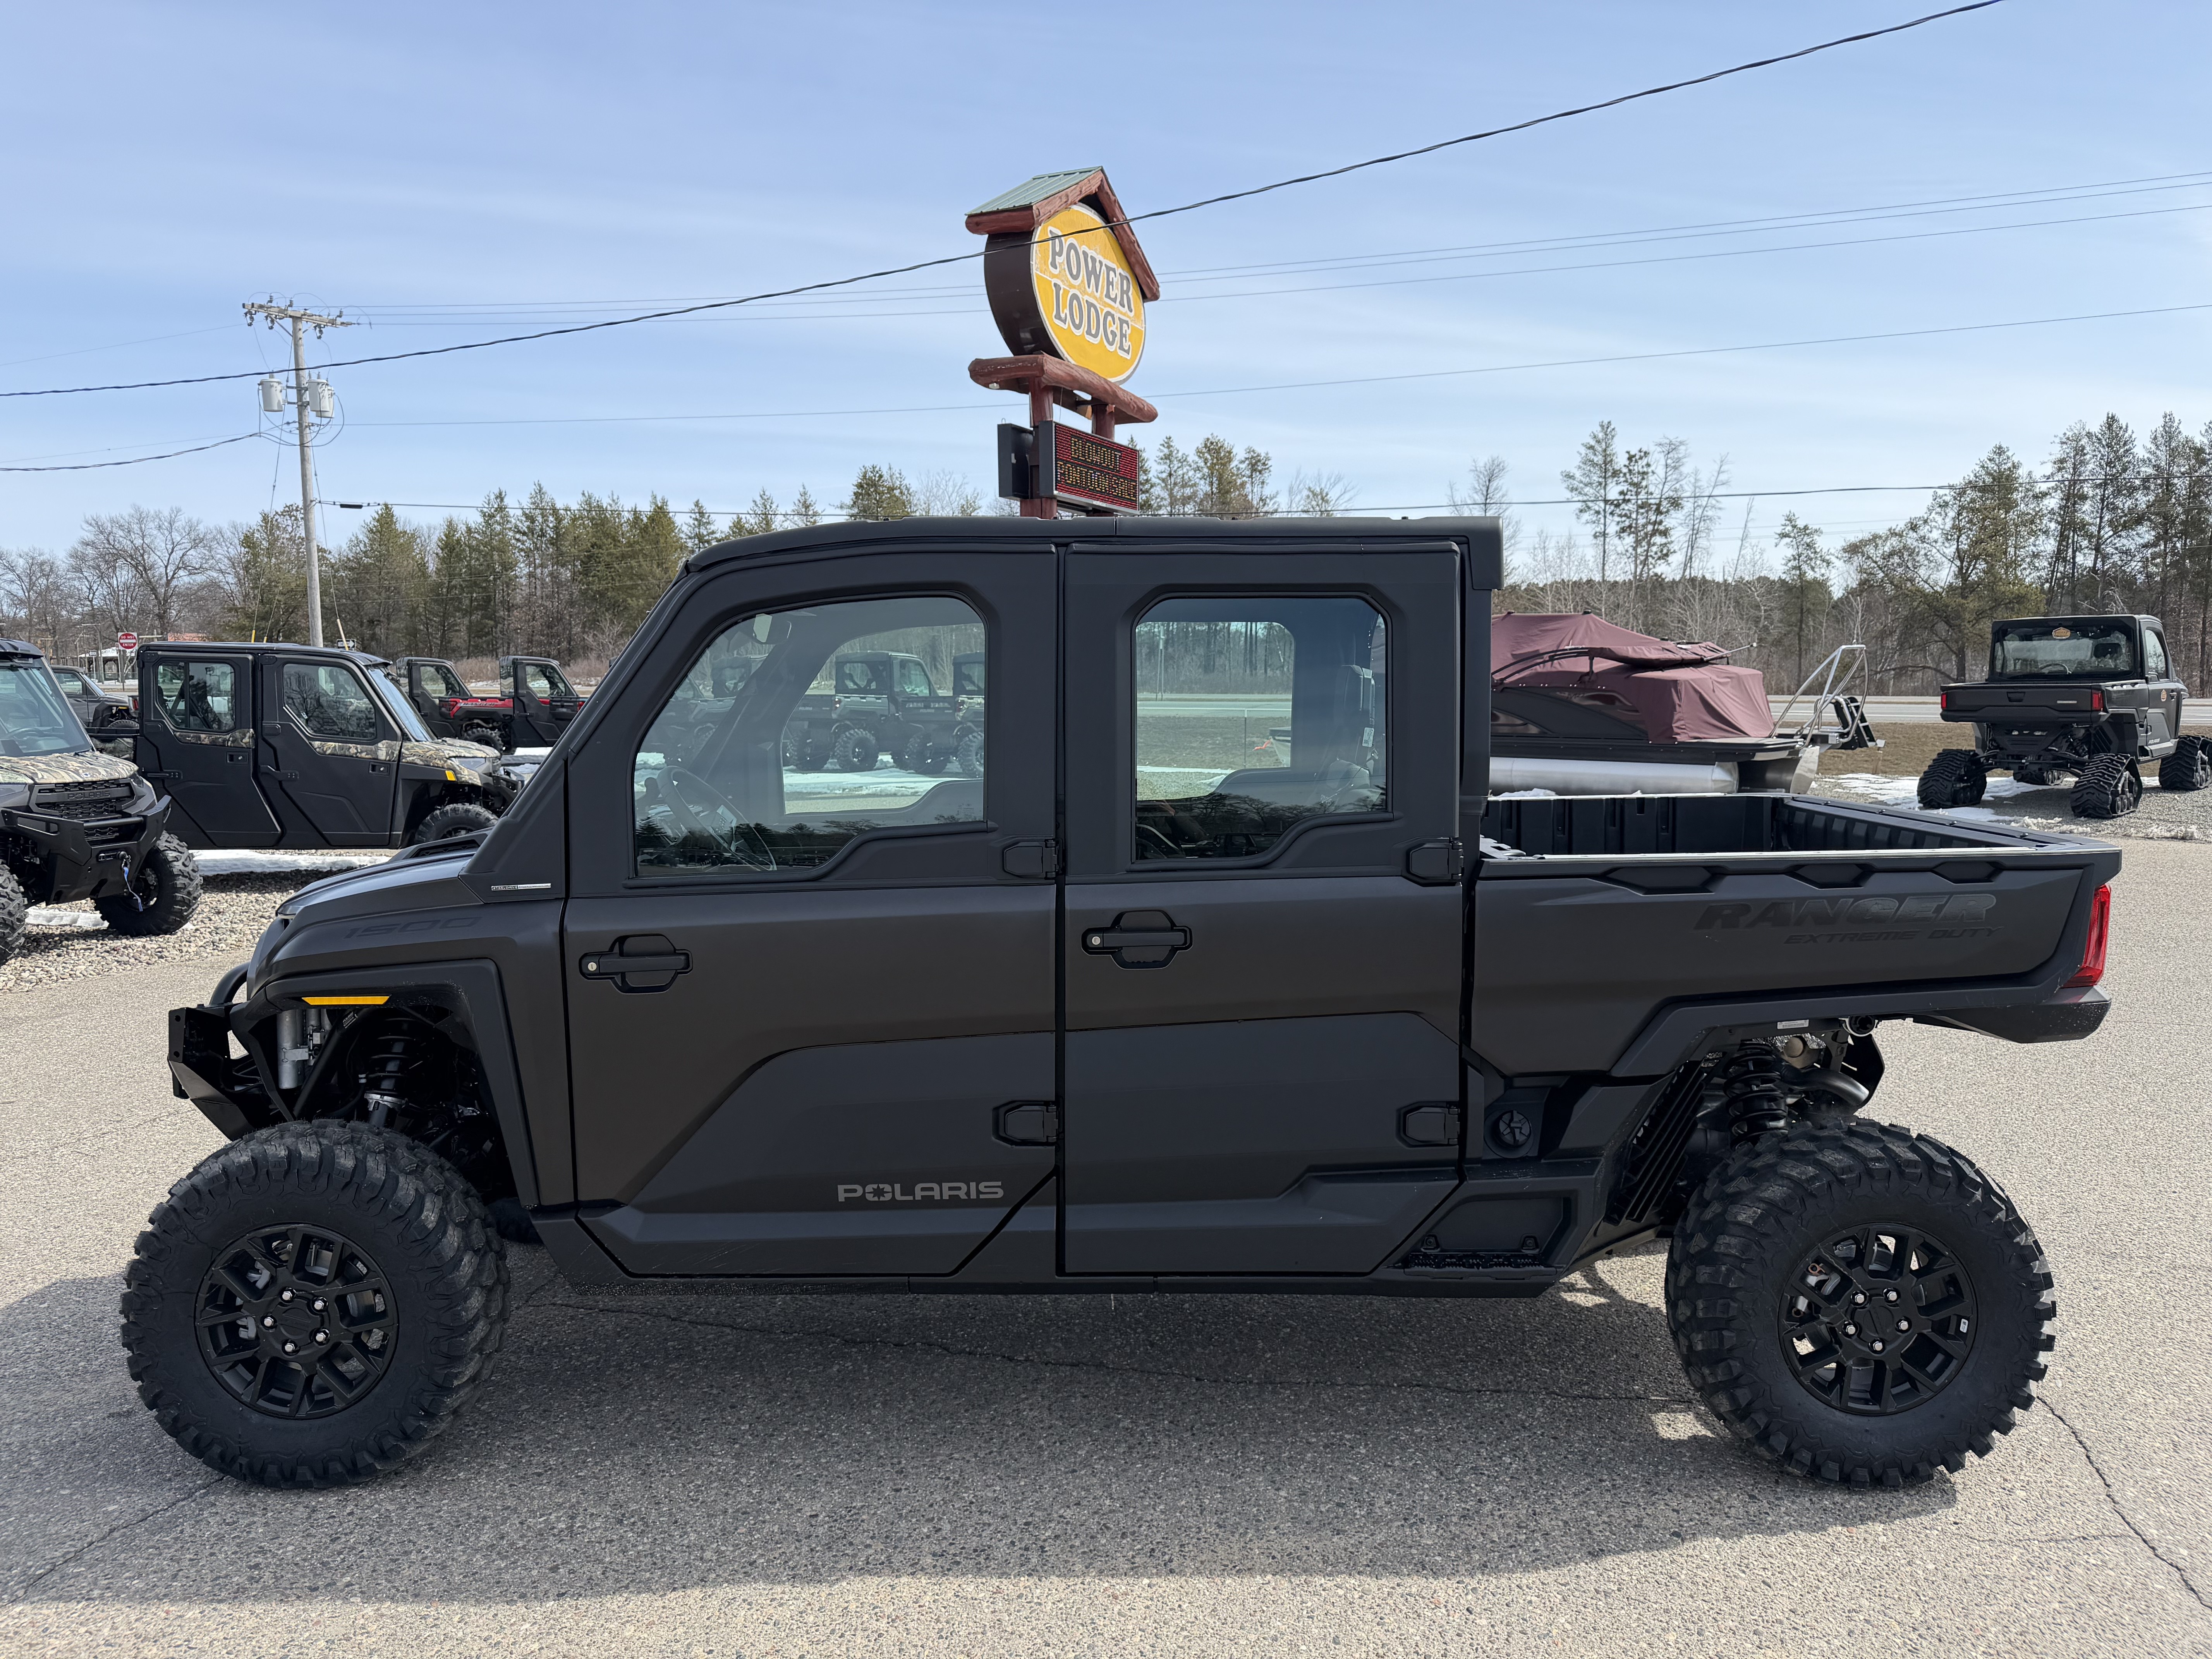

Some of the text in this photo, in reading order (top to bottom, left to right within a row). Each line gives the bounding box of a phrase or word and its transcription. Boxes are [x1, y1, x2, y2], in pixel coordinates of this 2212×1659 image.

[1048, 227, 1134, 316] POWER
[1053, 280, 1132, 359] LODGE
[1071, 437, 1121, 471] BLOWOUT
[1057, 461, 1136, 500] PONTOON SALE
[67, 790, 110, 800] POLARIS
[343, 917, 483, 939] 1500
[1693, 894, 1996, 930] RANGER
[1783, 927, 2004, 944] EXTREME DUTY
[837, 1181, 1004, 1202] POLARIS
